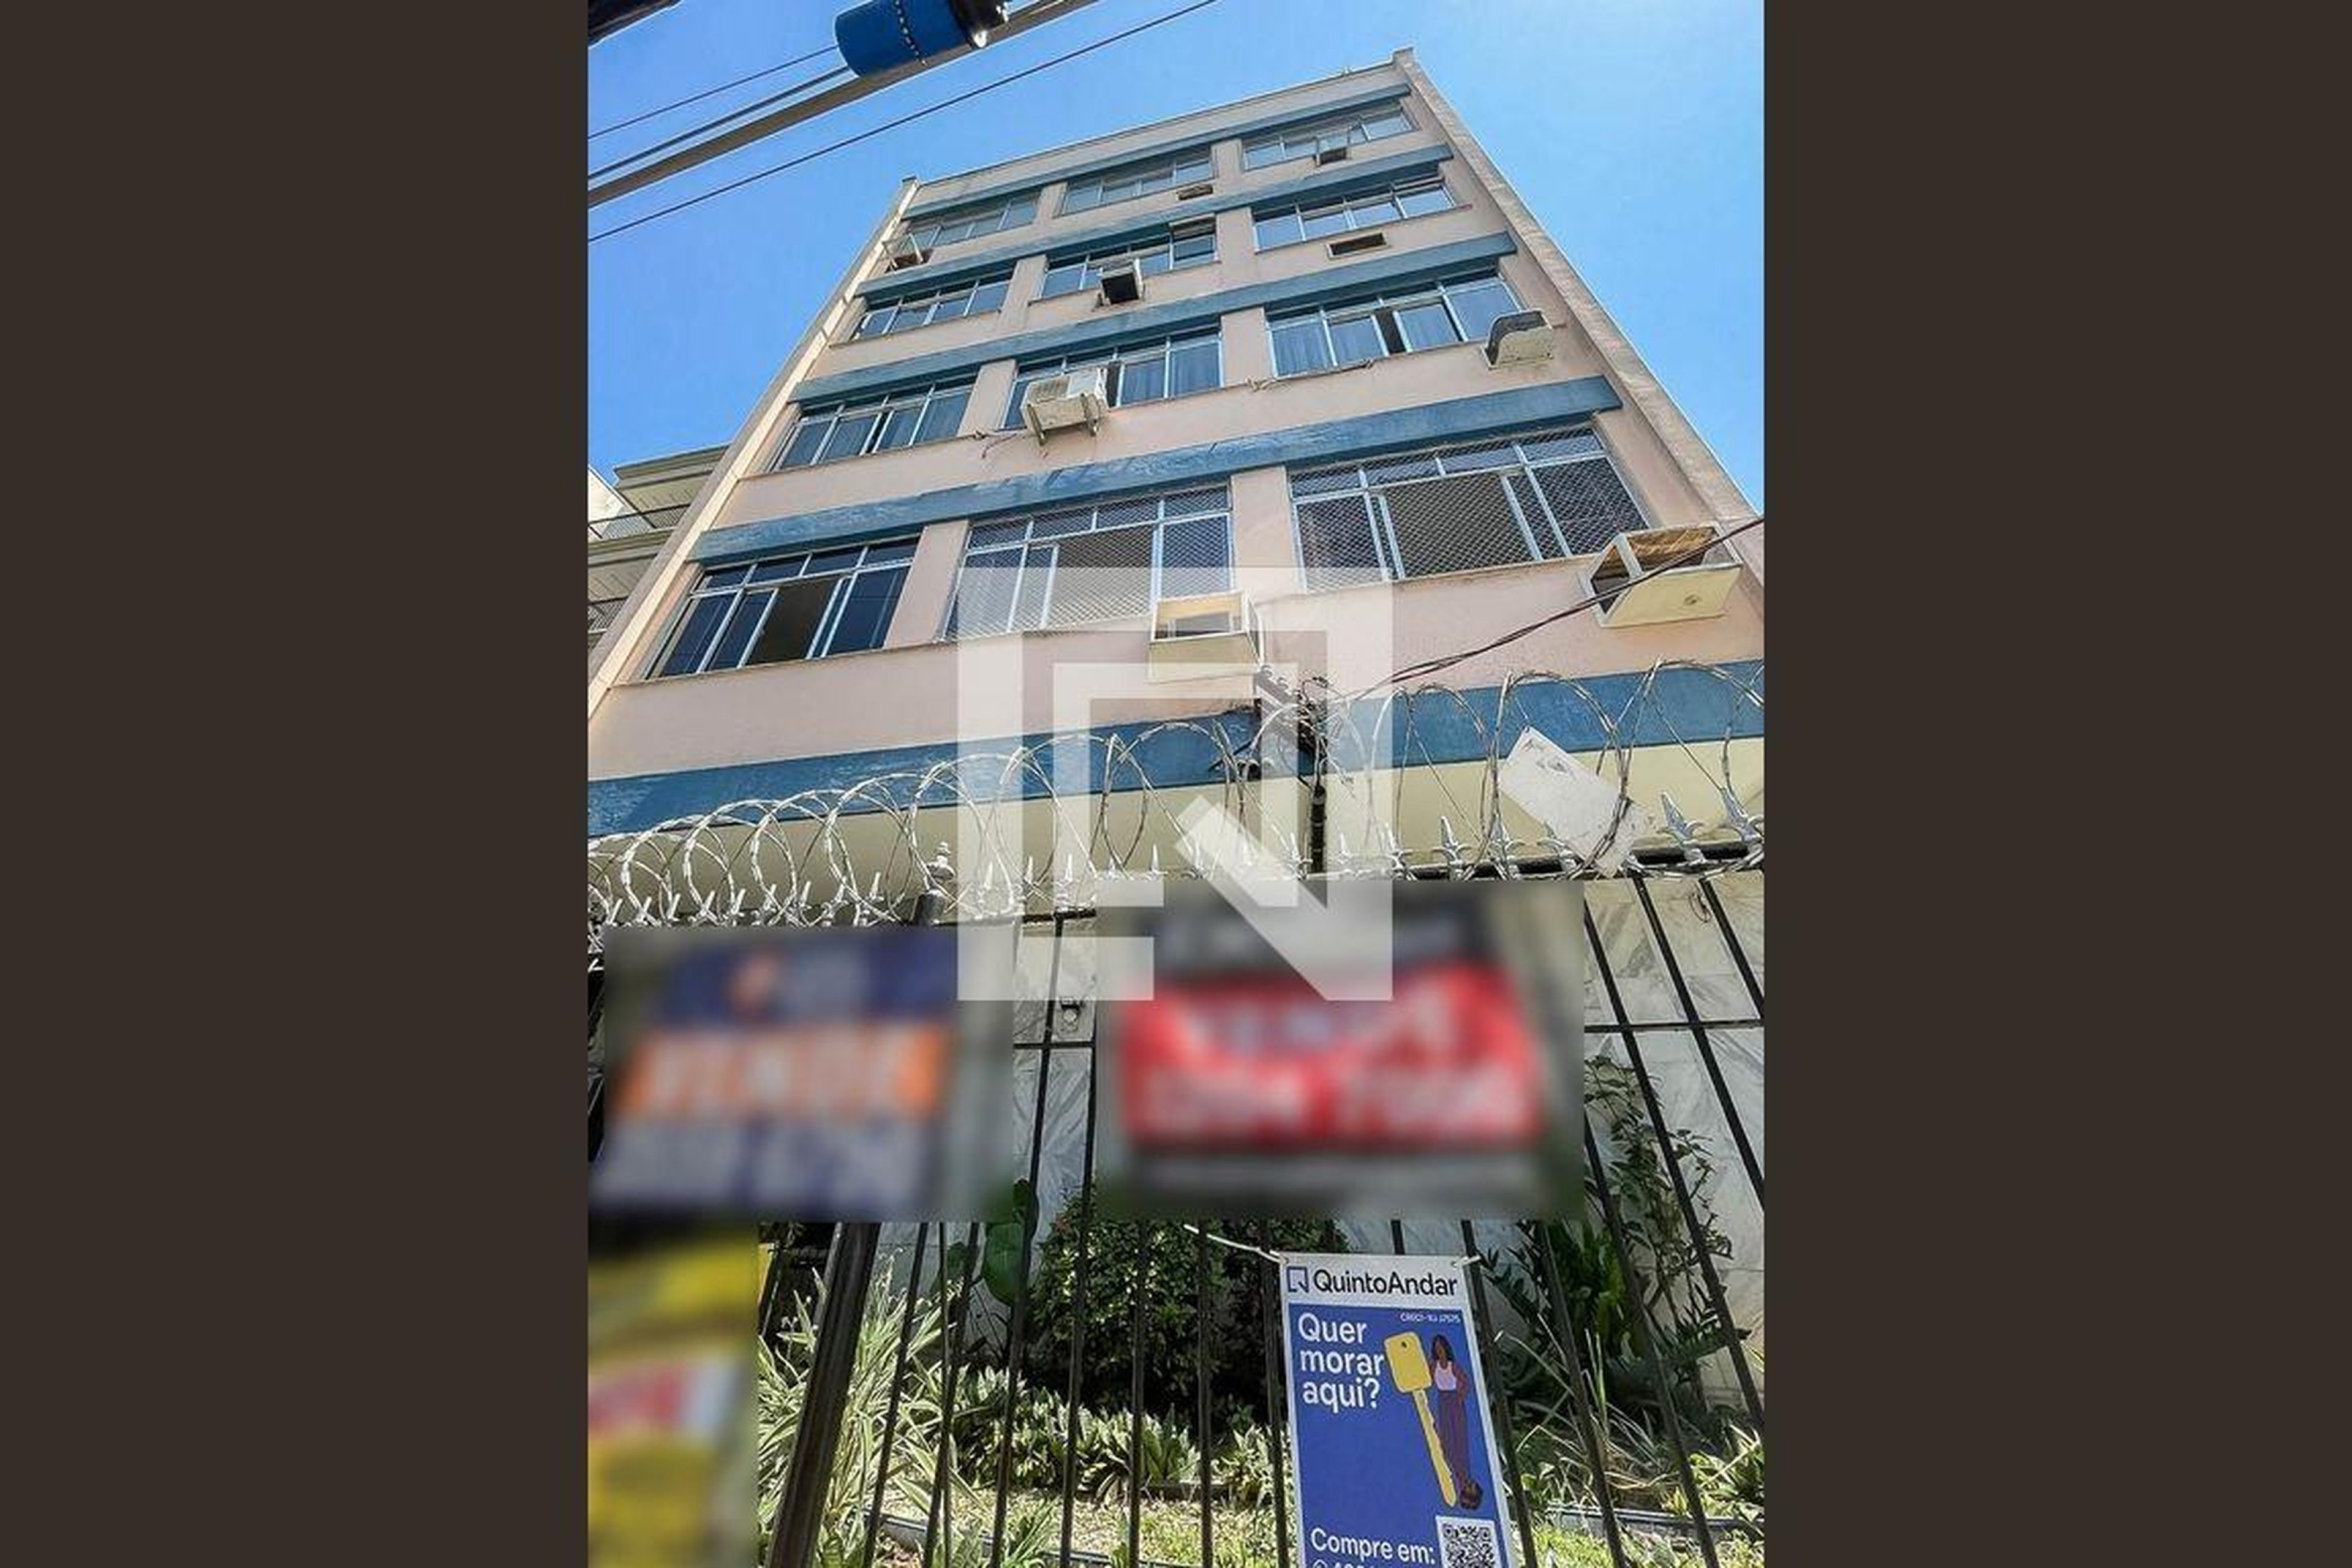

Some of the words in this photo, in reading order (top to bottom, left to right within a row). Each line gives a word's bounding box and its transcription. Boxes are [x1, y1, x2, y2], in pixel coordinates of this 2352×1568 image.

[1313, 1269, 1458, 1296] QuintoAndar
[1298, 1313, 1367, 1344] Quer
[1300, 1349, 1384, 1376] morar
[1302, 1378, 1380, 1414] aqui?
[1311, 1528, 1393, 1562] Compre
[1397, 1544, 1436, 1564] em:
